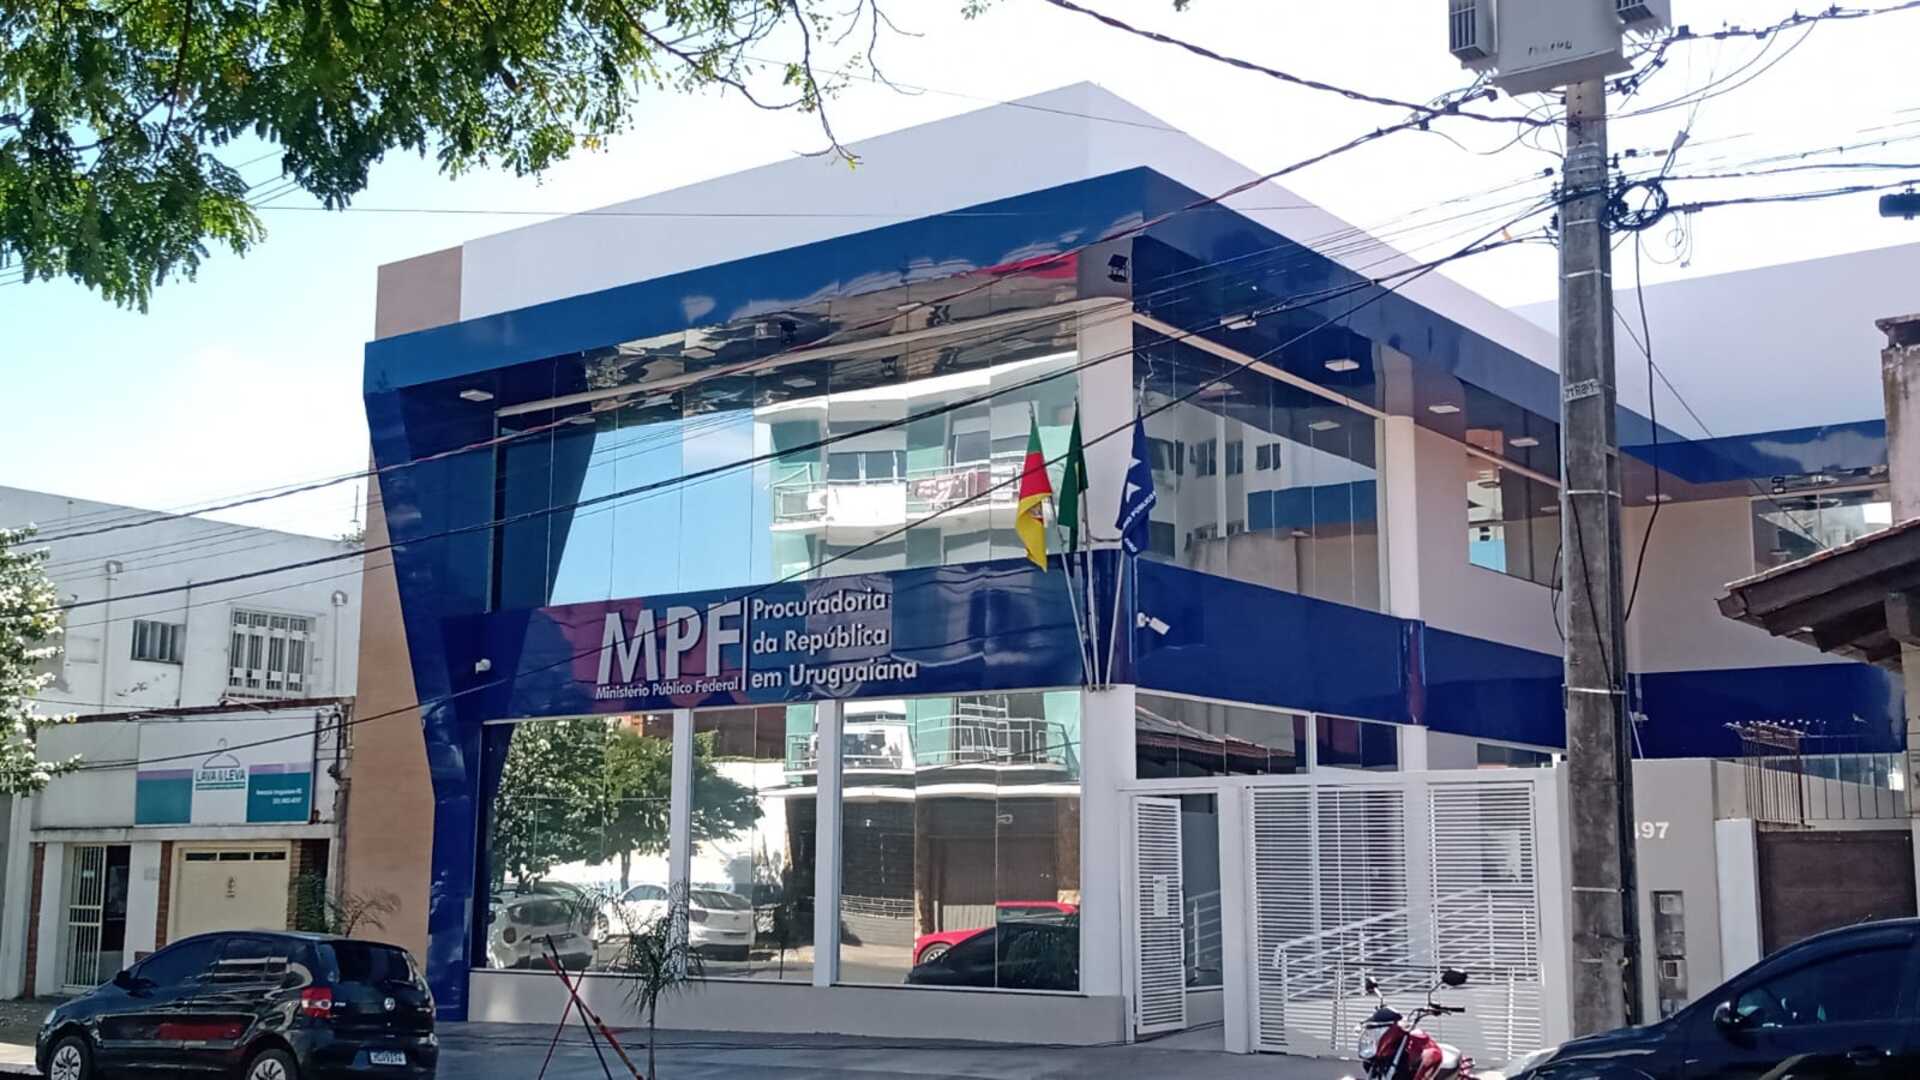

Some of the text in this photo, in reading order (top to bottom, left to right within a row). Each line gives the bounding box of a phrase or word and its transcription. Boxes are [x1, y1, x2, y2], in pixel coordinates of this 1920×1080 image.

[752, 586, 887, 621] Procuradoria
[597, 601, 741, 685] MPF
[752, 624, 887, 656] da República
[595, 676, 739, 700] Ministério Público Federal
[751, 658, 918, 689] em Uruguaiana
